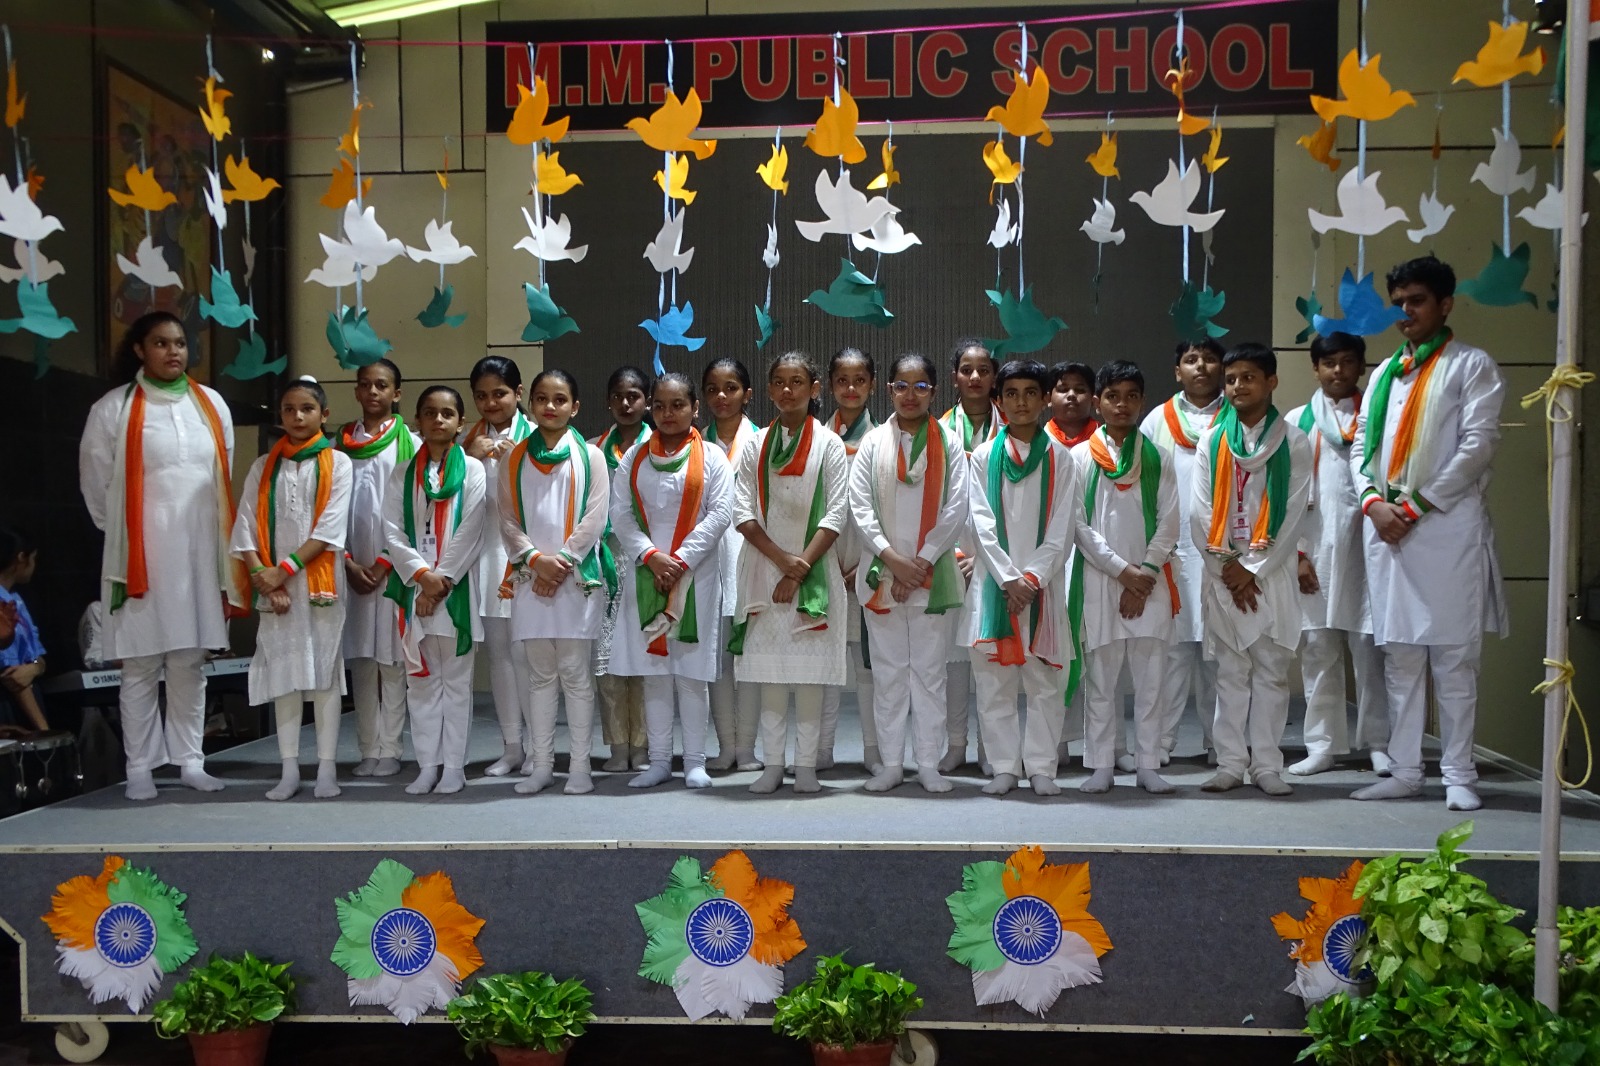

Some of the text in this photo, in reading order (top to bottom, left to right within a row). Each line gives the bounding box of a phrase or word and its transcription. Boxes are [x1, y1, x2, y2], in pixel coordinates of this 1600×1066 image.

[504, 23, 1313, 108] M.M. PUBLIC SCHOOL
